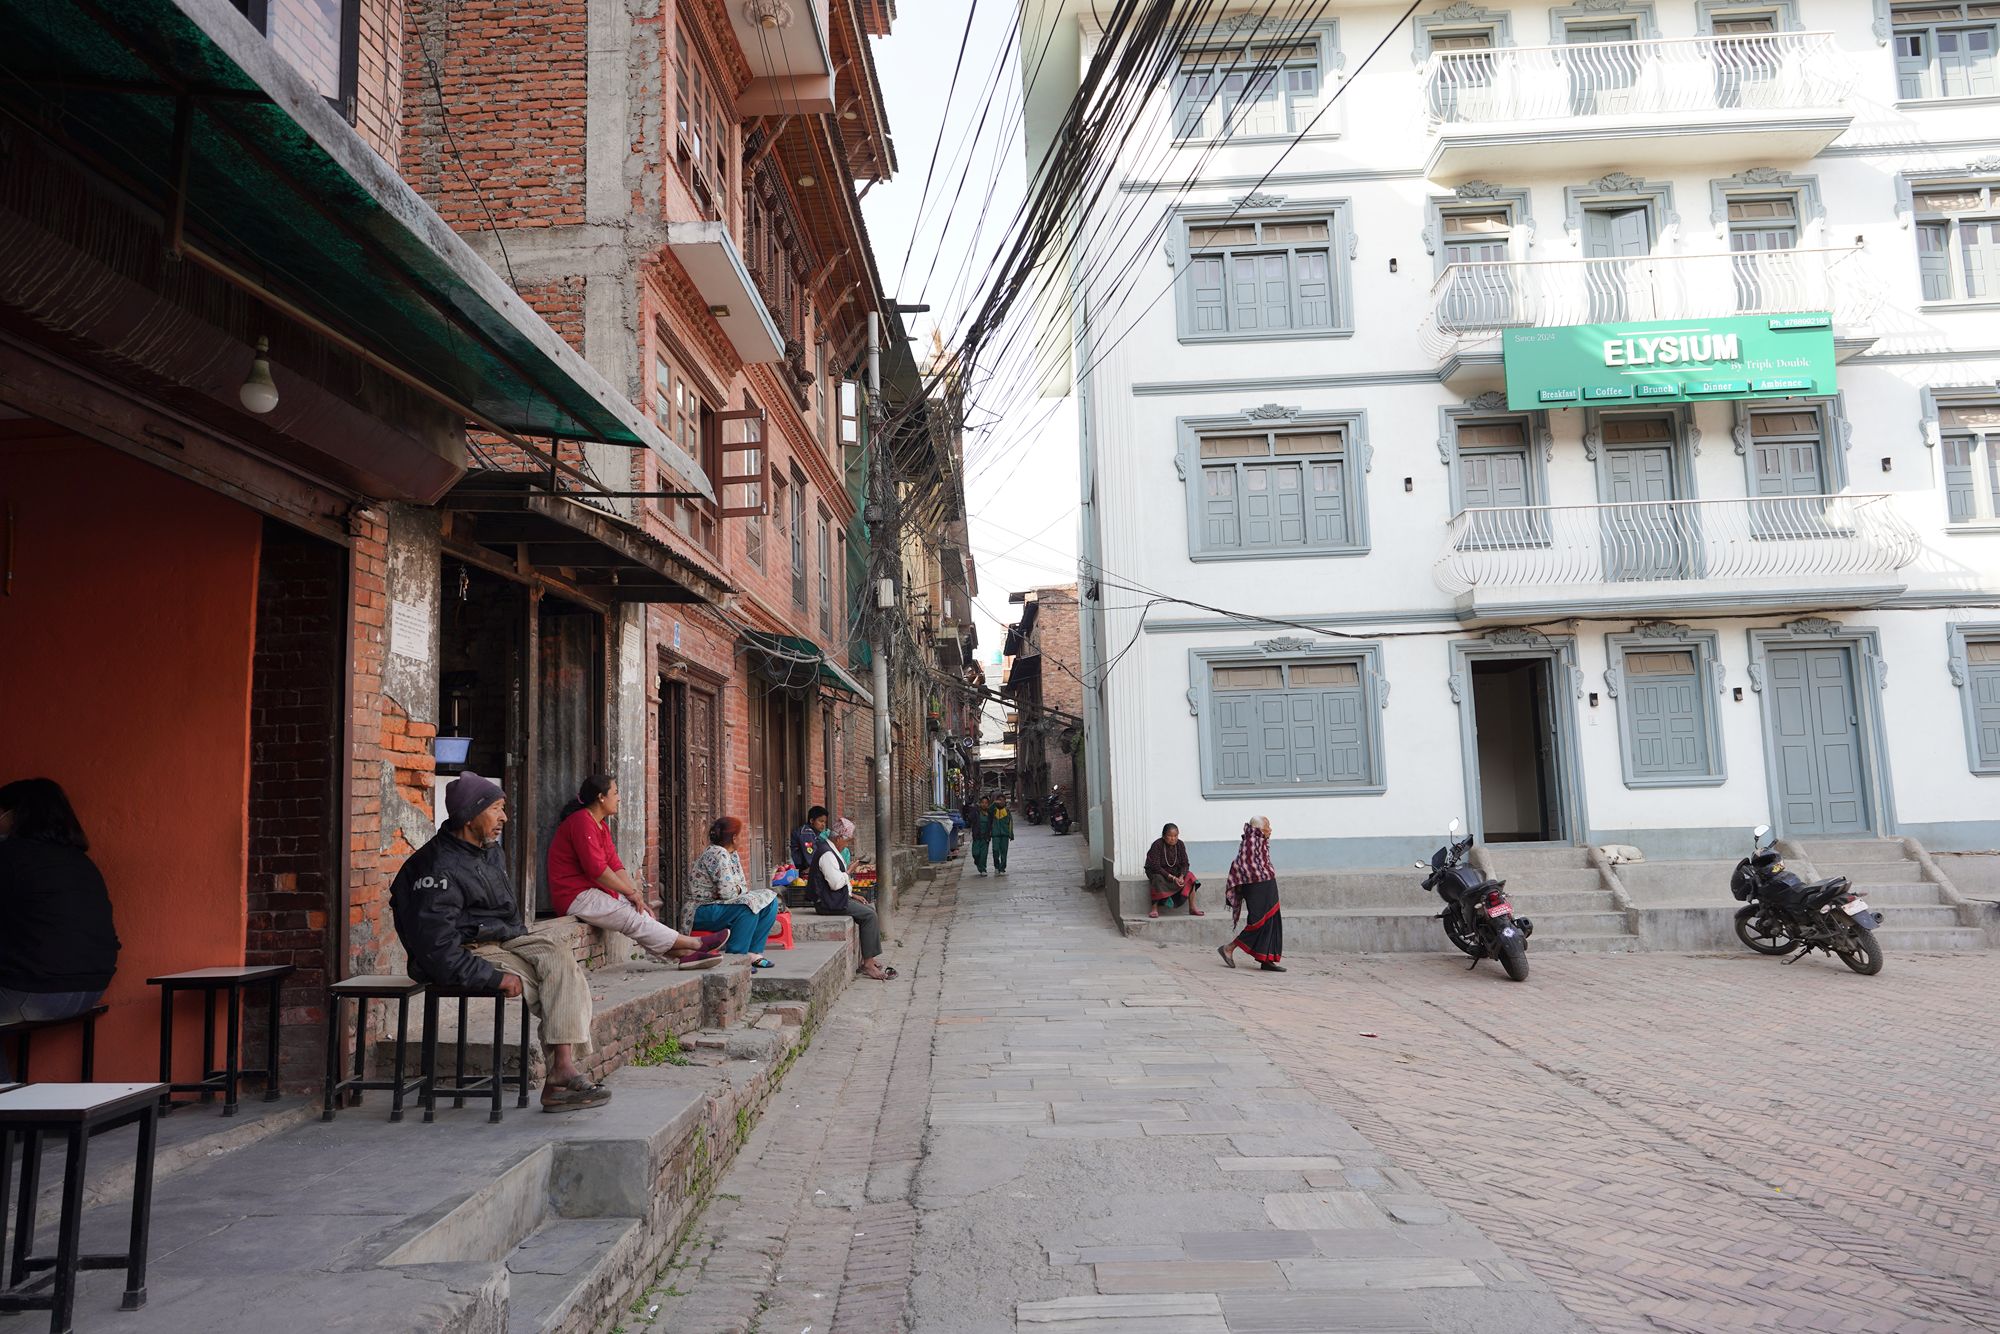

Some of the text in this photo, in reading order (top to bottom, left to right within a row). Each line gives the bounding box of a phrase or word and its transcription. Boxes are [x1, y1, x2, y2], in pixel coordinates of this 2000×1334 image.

[1514, 333, 1556, 343] Since 2024
[1603, 333, 1739, 367] ELYSIUM
[1747, 359, 1773, 371] Triple
[1776, 357, 1810, 368] Double
[1541, 380, 1803, 399] Breakfast Coffee Brunch Dinner Ambience
[412, 876, 448, 891] NO.1
